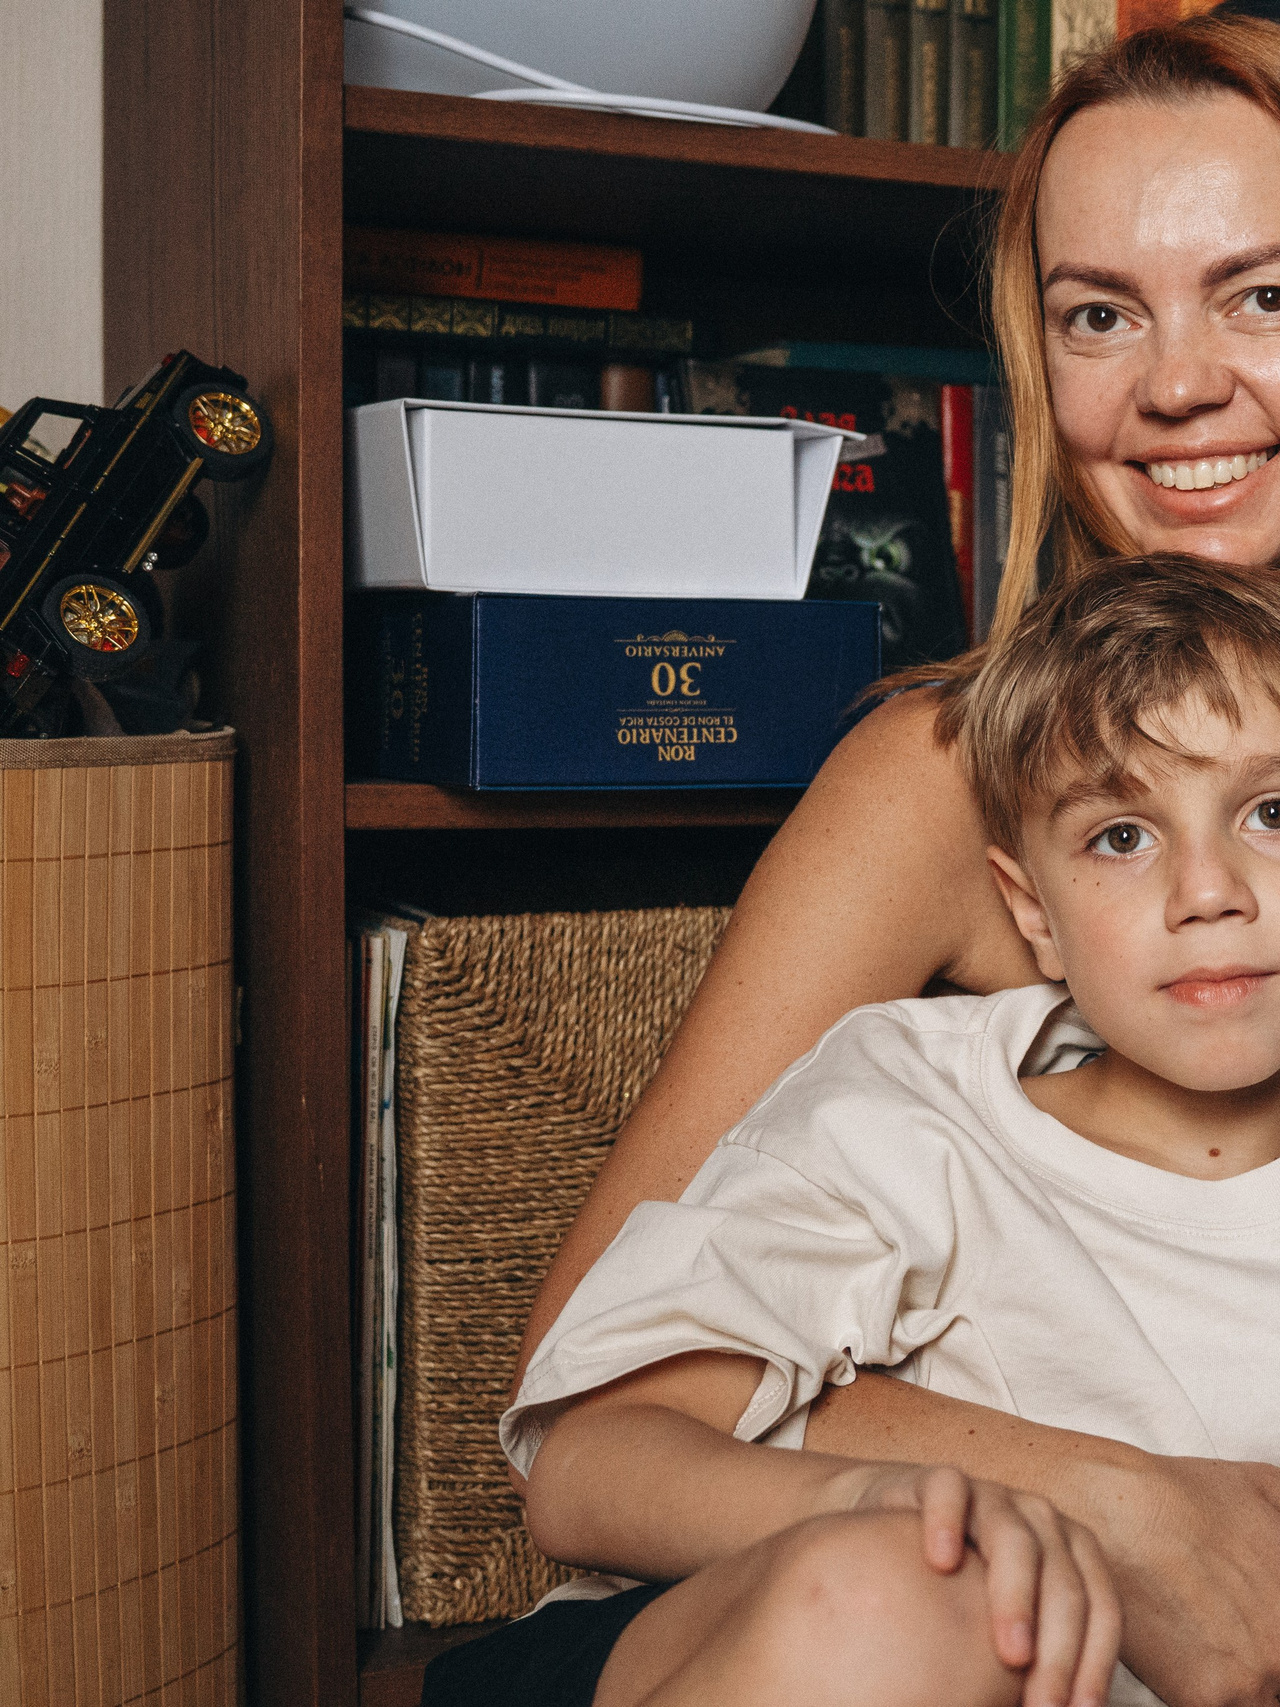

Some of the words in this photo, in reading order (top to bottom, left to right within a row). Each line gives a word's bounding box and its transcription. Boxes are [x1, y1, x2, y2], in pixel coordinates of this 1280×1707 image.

[625, 645, 726, 658] ANIVERSARIO
[651, 661, 702, 697] 30
[619, 717, 644, 726] RICA
[646, 716, 680, 726] COSTA
[682, 716, 696, 726] DE
[698, 716, 720, 726] RON
[722, 716, 734, 725] EL
[617, 727, 738, 745] CENTENARIO
[657, 745, 696, 761] RON
